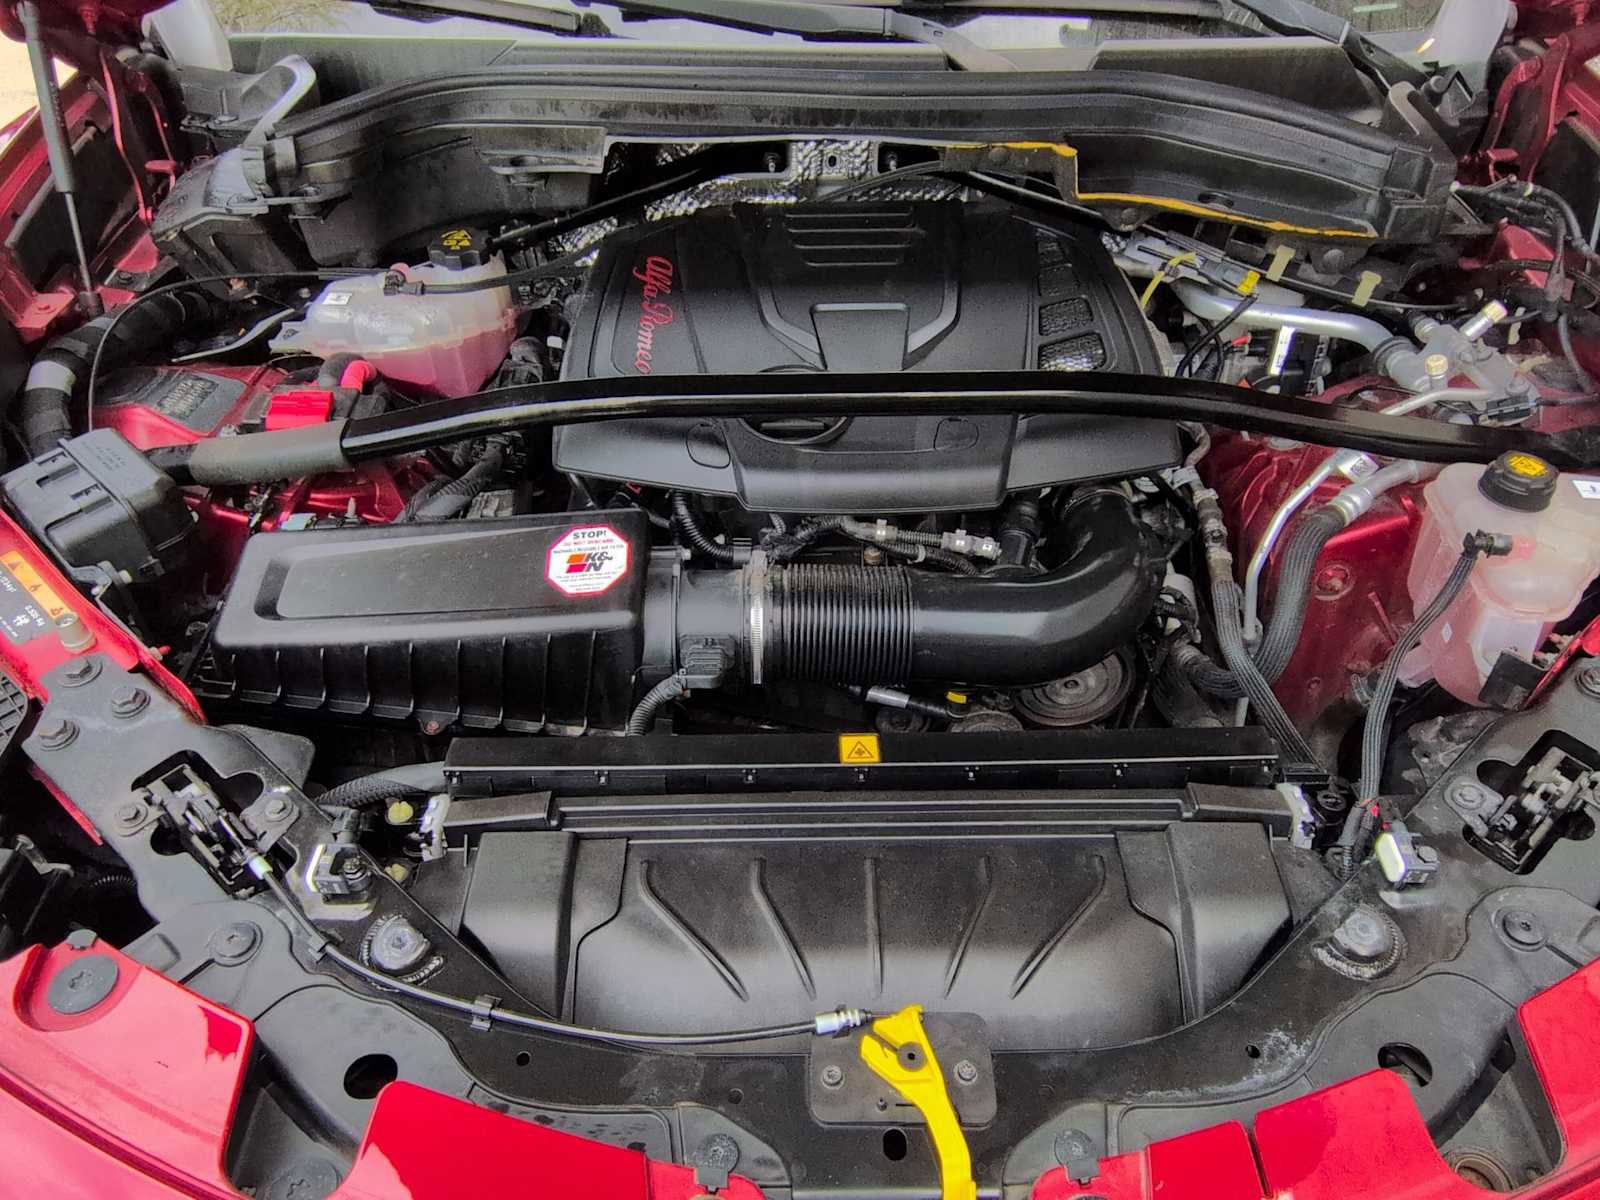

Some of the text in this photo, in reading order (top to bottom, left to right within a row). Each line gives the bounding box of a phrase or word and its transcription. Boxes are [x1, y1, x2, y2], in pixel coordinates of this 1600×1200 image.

[632, 255, 673, 375] Alfa Romeo
[573, 530, 607, 539] STOP!
